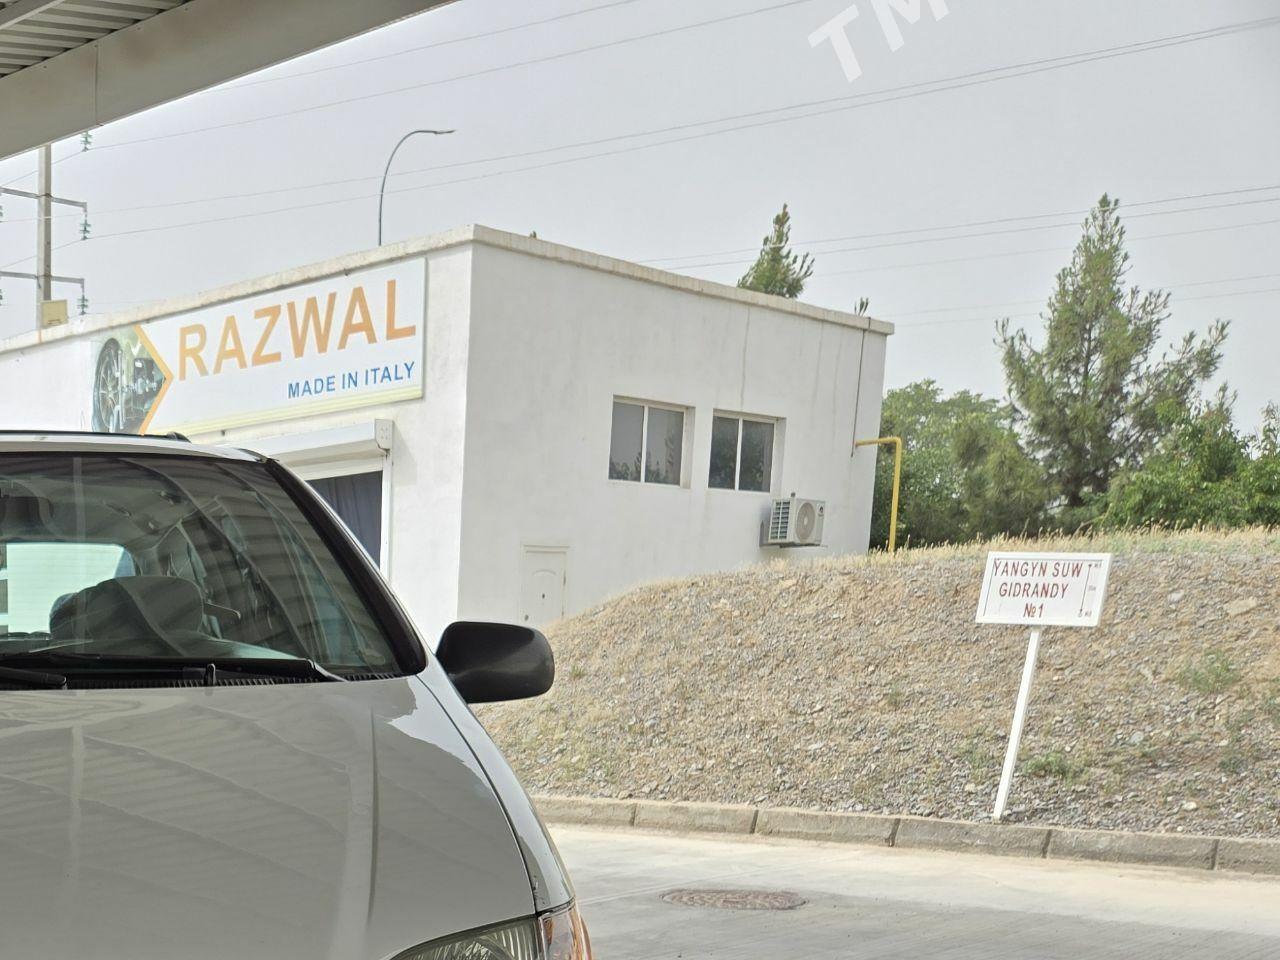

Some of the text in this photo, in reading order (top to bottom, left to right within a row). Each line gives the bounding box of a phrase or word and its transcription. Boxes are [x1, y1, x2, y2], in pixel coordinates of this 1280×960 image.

[178, 279, 417, 381] RAZWAL
[288, 361, 415, 398] MADE IN ITALY
[993, 560, 1084, 578] YANGYN SUW
[999, 582, 1069, 598] GIDRANDY
